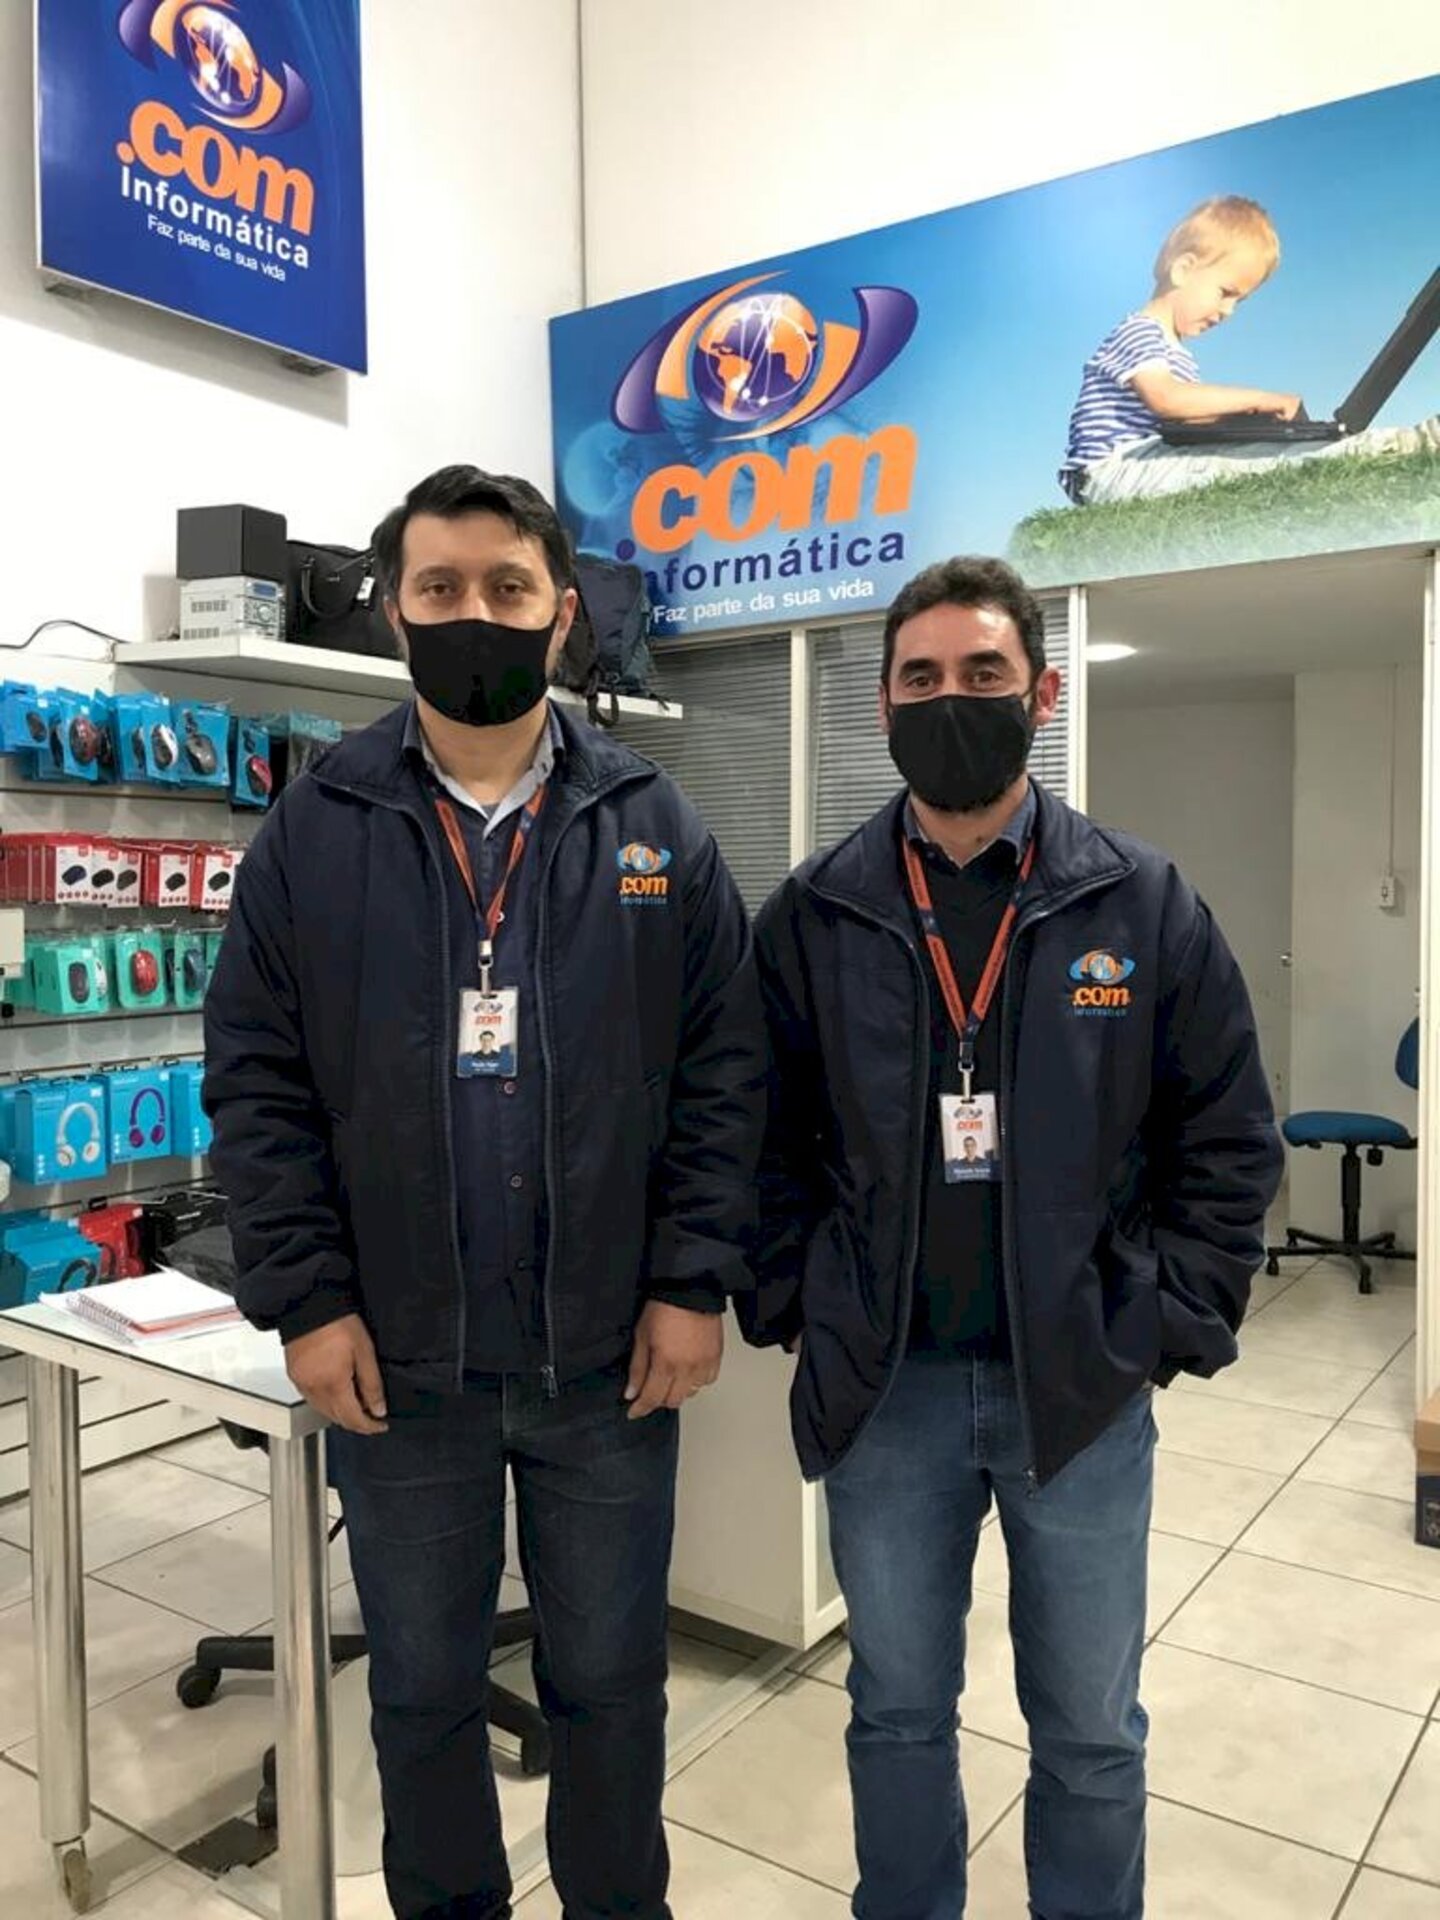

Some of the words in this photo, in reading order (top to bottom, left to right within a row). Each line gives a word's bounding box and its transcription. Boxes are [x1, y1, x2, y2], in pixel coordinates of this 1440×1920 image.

[116, 100, 314, 236] .com
[147, 213, 174, 239] Faz
[177, 229, 211, 252] parte
[213, 242, 231, 261] da
[235, 252, 258, 271] sua
[261, 261, 286, 282] vida
[643, 531, 906, 596] nformática
[652, 604, 688, 624] Faz
[693, 598, 743, 624] parte
[749, 593, 775, 612] da
[783, 588, 821, 607] sua
[828, 578, 874, 601] vida
